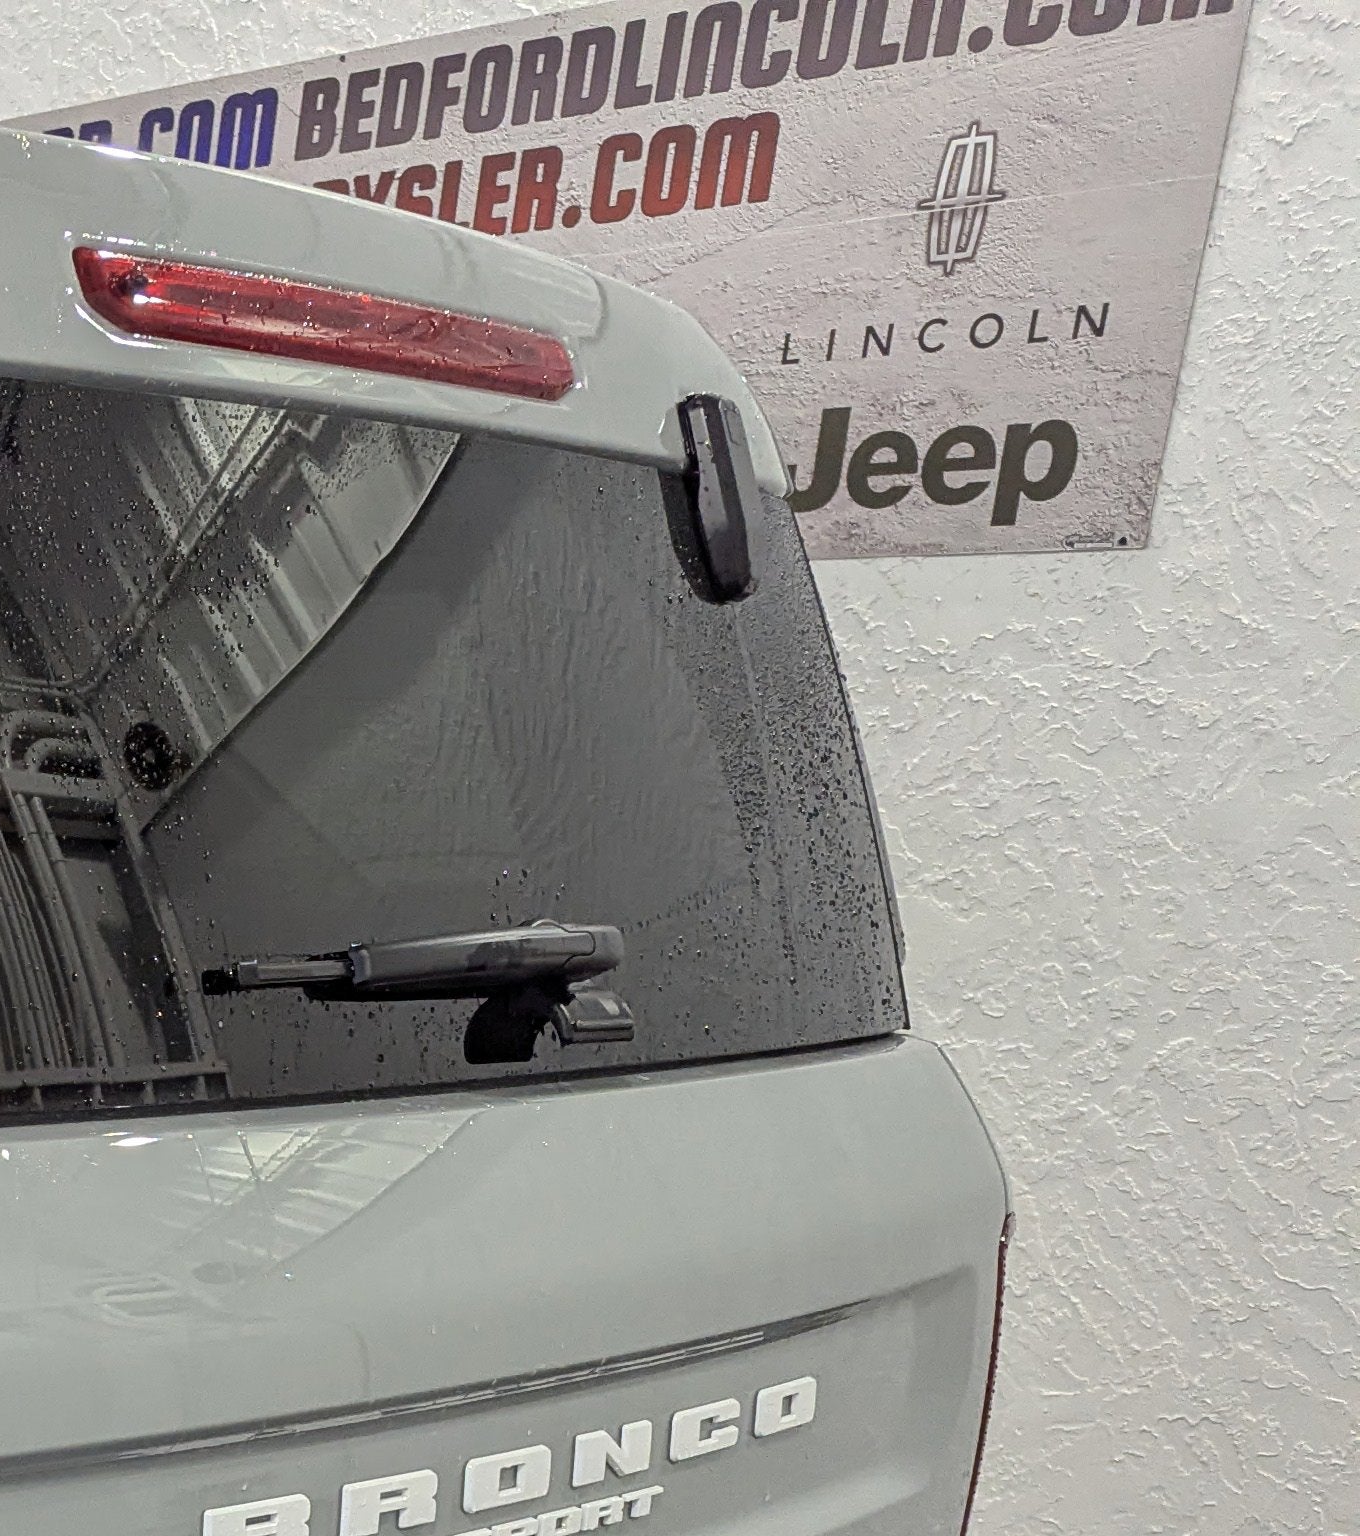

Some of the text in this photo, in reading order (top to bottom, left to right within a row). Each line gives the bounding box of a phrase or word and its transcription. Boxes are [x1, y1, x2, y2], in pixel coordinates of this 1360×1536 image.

[294, 0, 1235, 161] BEDFORDLINCOLN.
[780, 303, 1110, 364] LINCOLN
[788, 406, 1078, 527] Jeep
